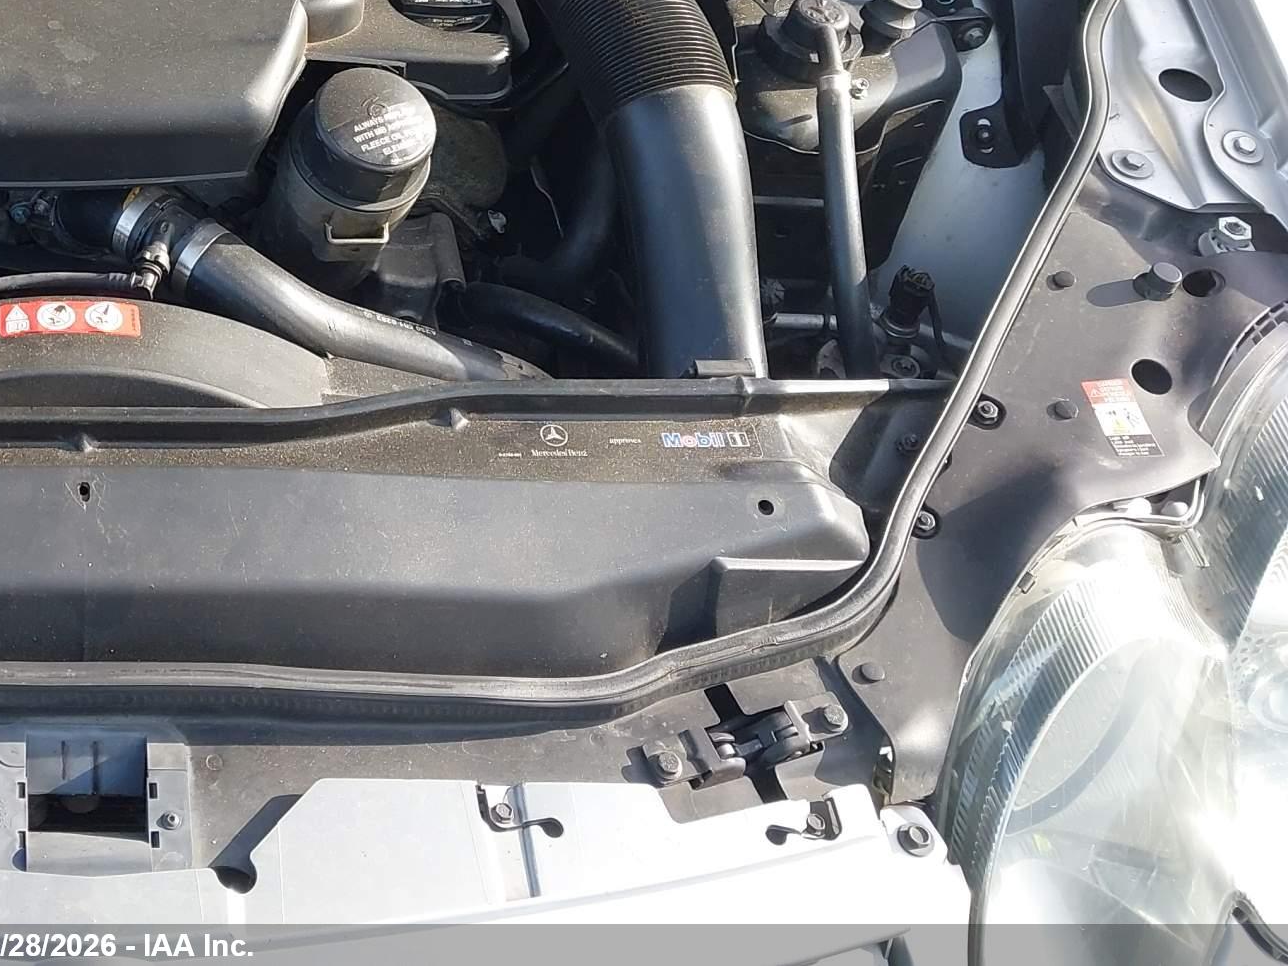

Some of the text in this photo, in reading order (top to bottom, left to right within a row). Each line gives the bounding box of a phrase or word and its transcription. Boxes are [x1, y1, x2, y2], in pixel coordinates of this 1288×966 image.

[353, 116, 384, 133] ALWAYS
[353, 130, 375, 144] WITH
[360, 136, 391, 152] FLEECE
[661, 432, 725, 448] Mobil
